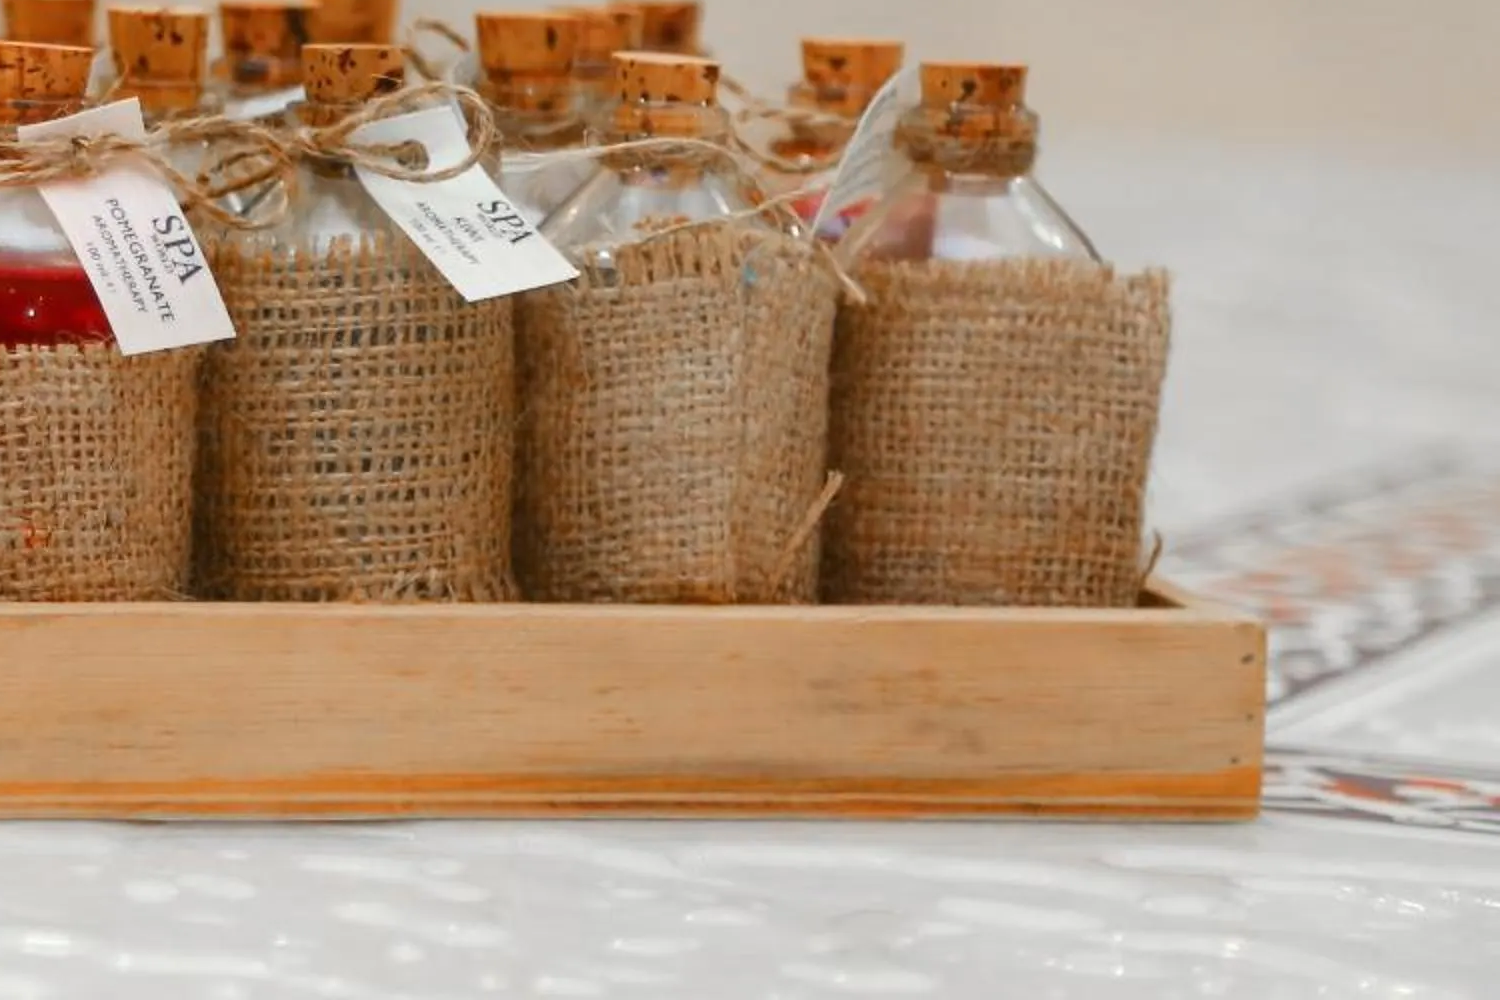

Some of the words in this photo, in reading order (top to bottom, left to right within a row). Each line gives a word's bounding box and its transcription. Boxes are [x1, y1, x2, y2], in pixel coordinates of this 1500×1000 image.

[92, 213, 148, 314] AROMATHERAPY
[105, 198, 176, 323] POMEGRANATE
[152, 214, 203, 285] SPA
[477, 200, 534, 245] SPA
